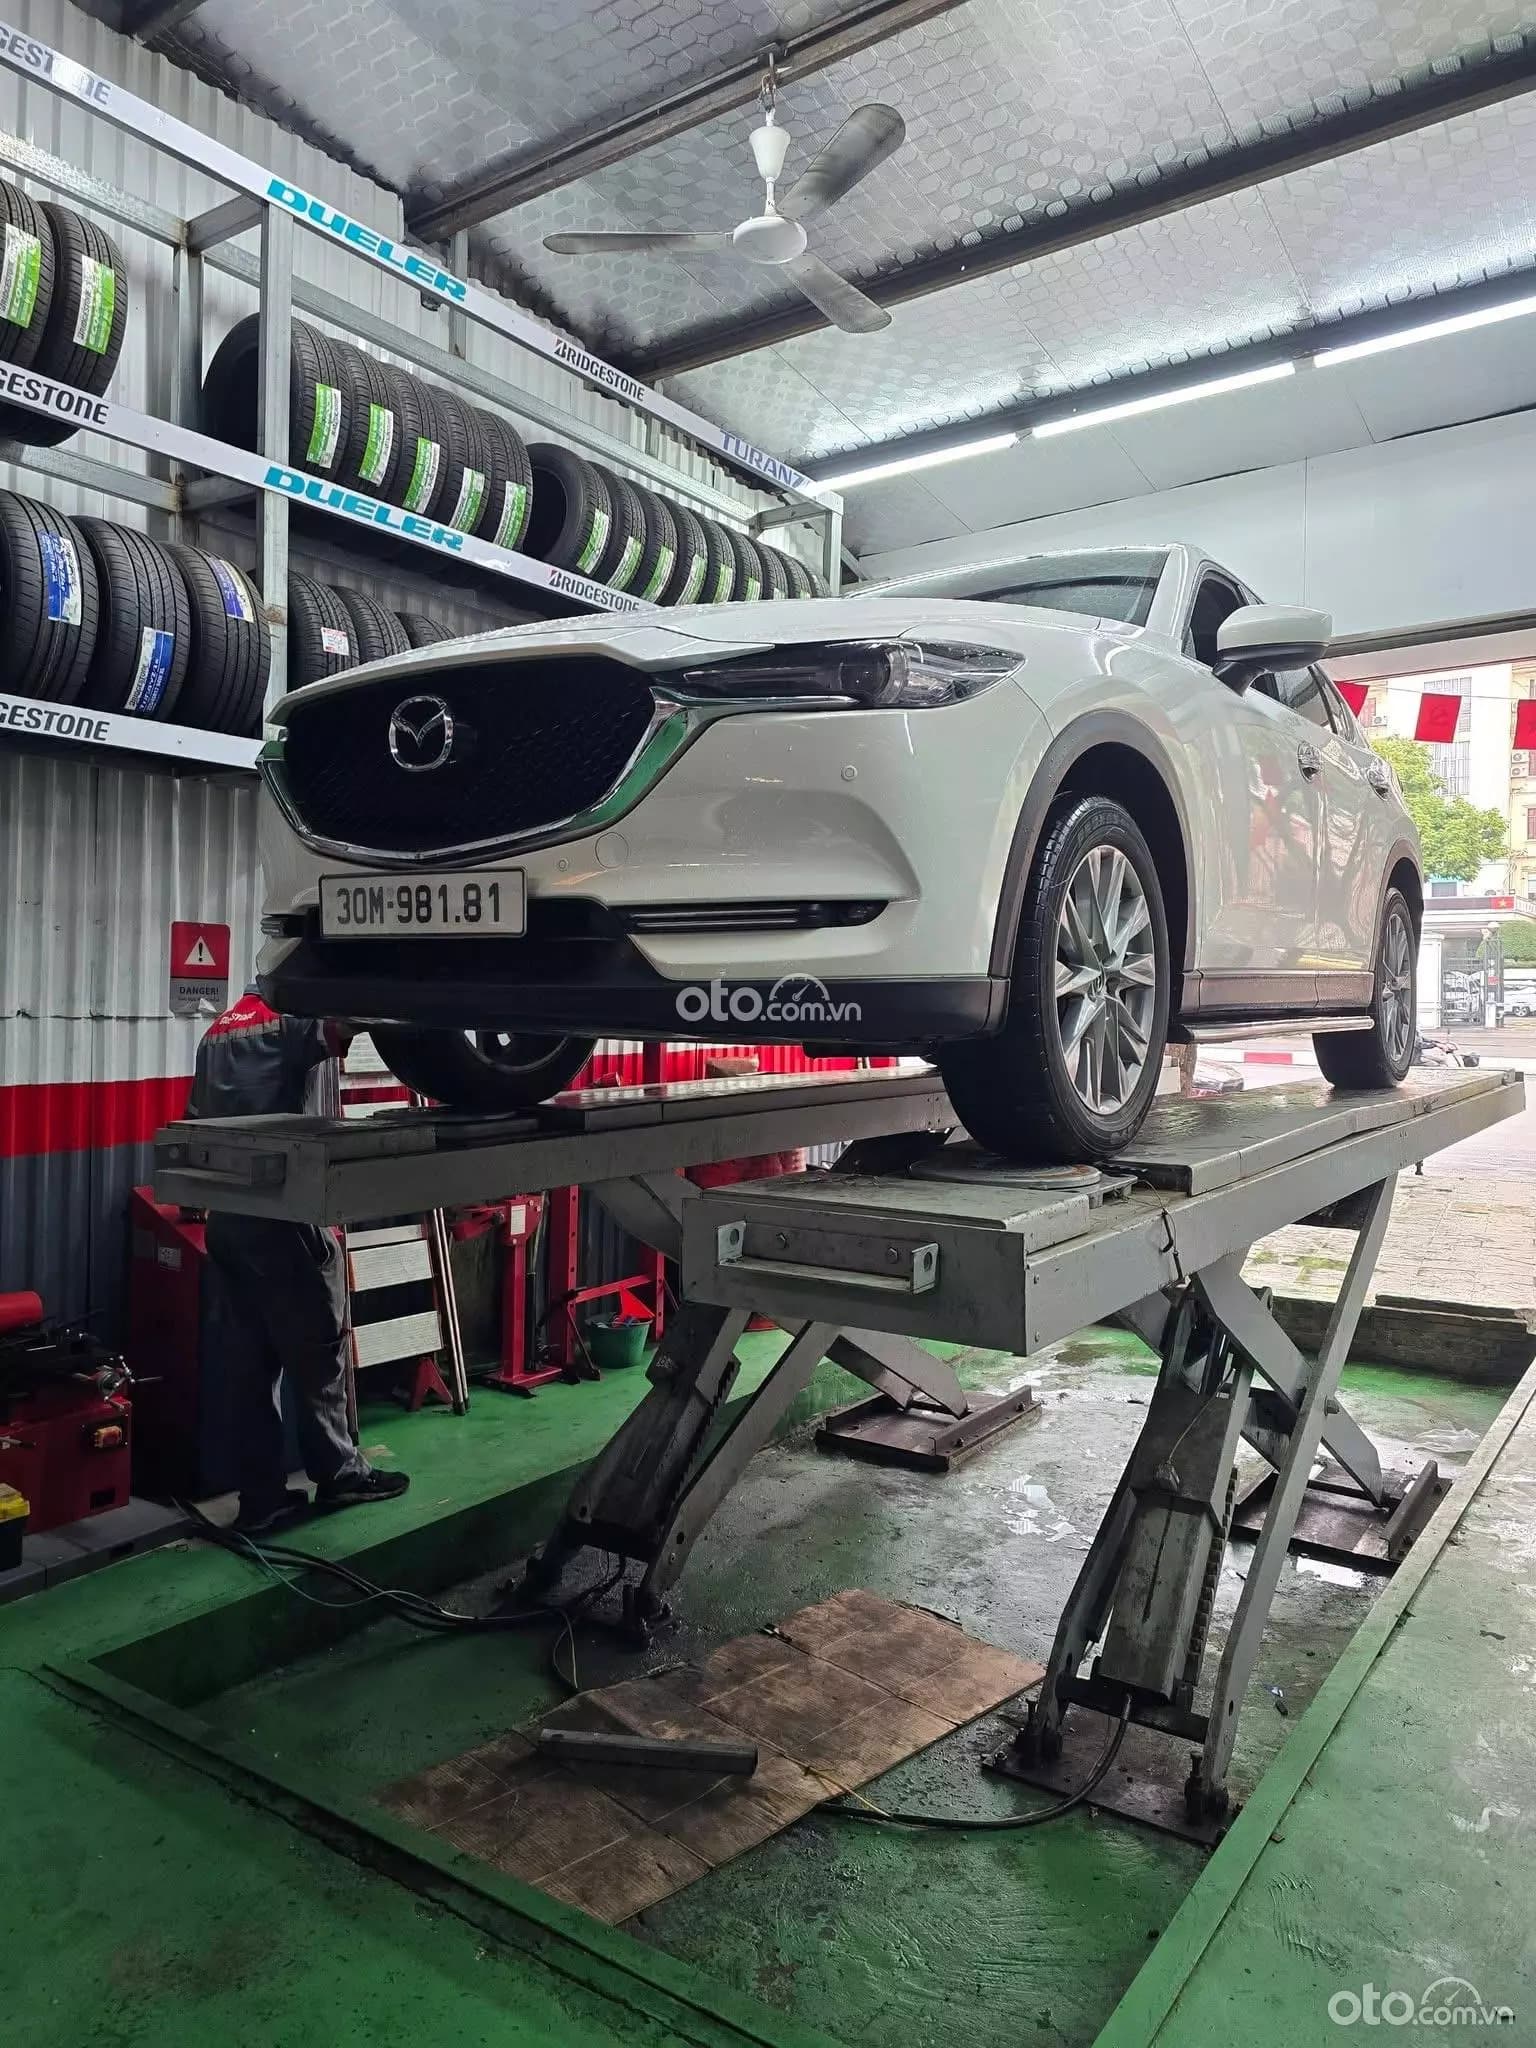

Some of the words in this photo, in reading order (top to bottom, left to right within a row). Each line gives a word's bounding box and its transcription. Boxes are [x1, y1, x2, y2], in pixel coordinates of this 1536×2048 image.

[266, 178, 467, 302] DUELER
[554, 338, 646, 402] BRIDGESTONE
[719, 429, 811, 489] TURANZ
[263, 466, 465, 552] DUELER
[336, 882, 500, 925] 30M-981.81
[179, 986, 219, 996] DANGER!
